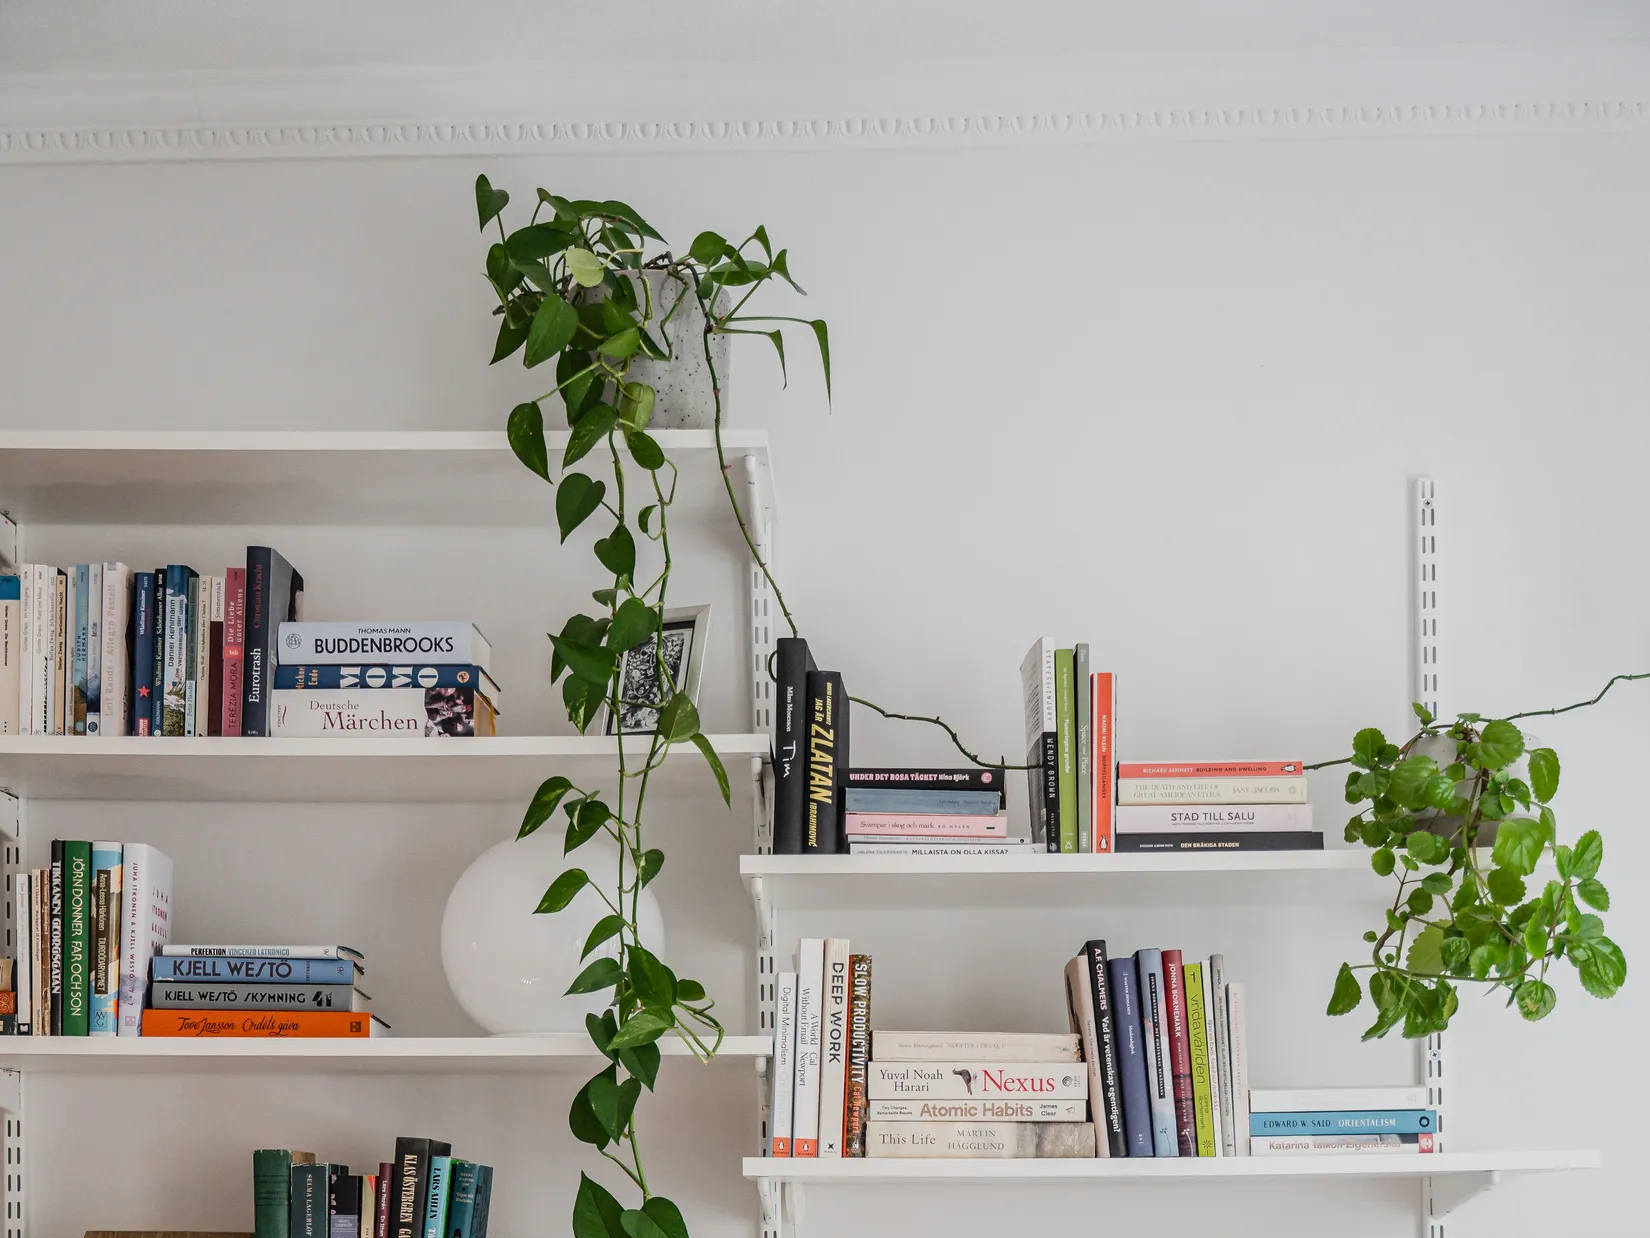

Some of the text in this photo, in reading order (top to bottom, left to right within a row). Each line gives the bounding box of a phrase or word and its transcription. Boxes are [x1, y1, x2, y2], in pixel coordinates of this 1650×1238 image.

[168, 599, 176, 640] Kehlmann
[227, 601, 235, 625] Liebe
[105, 585, 116, 716] Leif Randt Allegro Pastell
[315, 637, 454, 654] BUDDENBROOKS
[249, 648, 262, 703] Eurotrash
[227, 663, 238, 729] TERÉZIA MORA
[310, 700, 359, 710] Deutsche
[322, 710, 418, 730] Märchen
[782, 740, 796, 778] Tim
[808, 698, 834, 847] JAG ÄR ZLATAN IBRAHIMOVIĆ
[849, 772, 938, 781] UNDER DET ROSA TÄCKET
[1171, 812, 1255, 821] STAD TILL SALU
[70, 856, 85, 1016] JÖRN DONNER FAR OCH SON
[173, 959, 292, 978] KJELL WESTÖ
[165, 991, 194, 1001] KJELL
[198, 990, 237, 1002] WESTÖ
[243, 992, 306, 1003] SKYMNING
[1096, 963, 1108, 1010] CHALMERS
[801, 987, 810, 1045] Without Email
[828, 962, 844, 1064] DEEP WORK
[851, 963, 867, 1083] SLOW PRODUCTIVITY
[1101, 1016, 1110, 1032] Vad
[177, 1016, 200, 1031] Tove
[196, 1017, 235, 1036] Jansson
[780, 987, 792, 1066] Digital Minimalism
[810, 1020, 818, 1045] World
[1103, 1033, 1111, 1043] är
[1190, 994, 1207, 1084] vrida världen
[798, 1051, 808, 1086] Newport
[809, 1052, 818, 1066] Cal
[1103, 1044, 1115, 1086] vetenskap
[880, 1069, 943, 1080] Yuval Noah
[893, 1081, 930, 1092] Harari
[981, 1069, 1055, 1092] Nexus
[920, 1103, 1033, 1117] Atomic Habits
[1108, 1087, 1122, 1133] egentligen?
[1300, 1120, 1309, 1128] W.
[1338, 1119, 1396, 1127] ORIENTALISM
[878, 1133, 936, 1145] This Life
[948, 1140, 1005, 1150] HÄGGLUND
[403, 1154, 418, 1175] KLAS
[432, 1167, 442, 1191] LARS
[400, 1176, 418, 1223] ÖSTERGREN
[429, 1192, 440, 1220] AHLIN
[305, 1199, 313, 1236] LAGERLÖF
